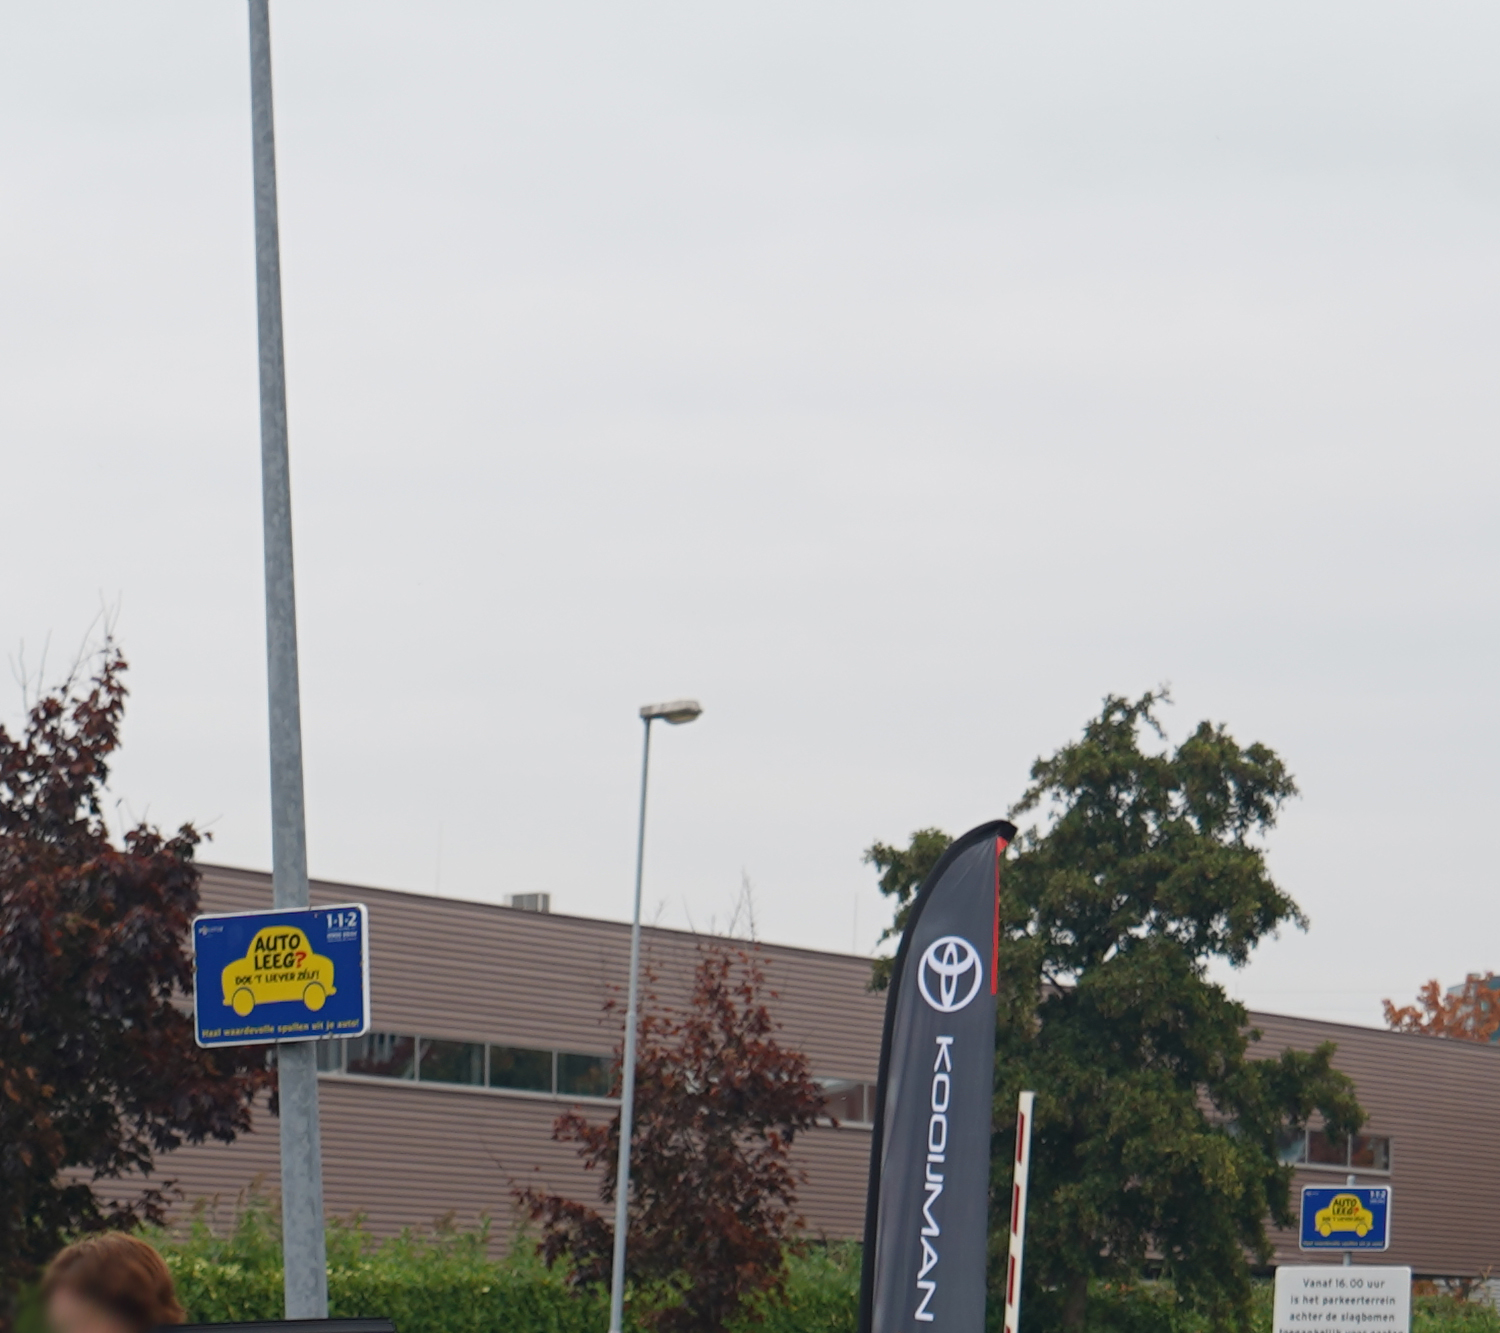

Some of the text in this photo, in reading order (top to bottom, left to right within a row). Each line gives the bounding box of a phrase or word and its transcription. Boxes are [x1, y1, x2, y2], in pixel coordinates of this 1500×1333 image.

[255, 934, 301, 952] AUTO
[254, 952, 307, 970] LEEG?
[914, 1035, 953, 1322] KOOIJMAN
[1303, 1278, 1333, 1288] Vanaf
[1367, 1280, 1385, 1288] uur
[1302, 1295, 1319, 1305] het
[1322, 1295, 1396, 1306] parkeerterrein
[1289, 1312, 1395, 1324] achter de slagbomen
